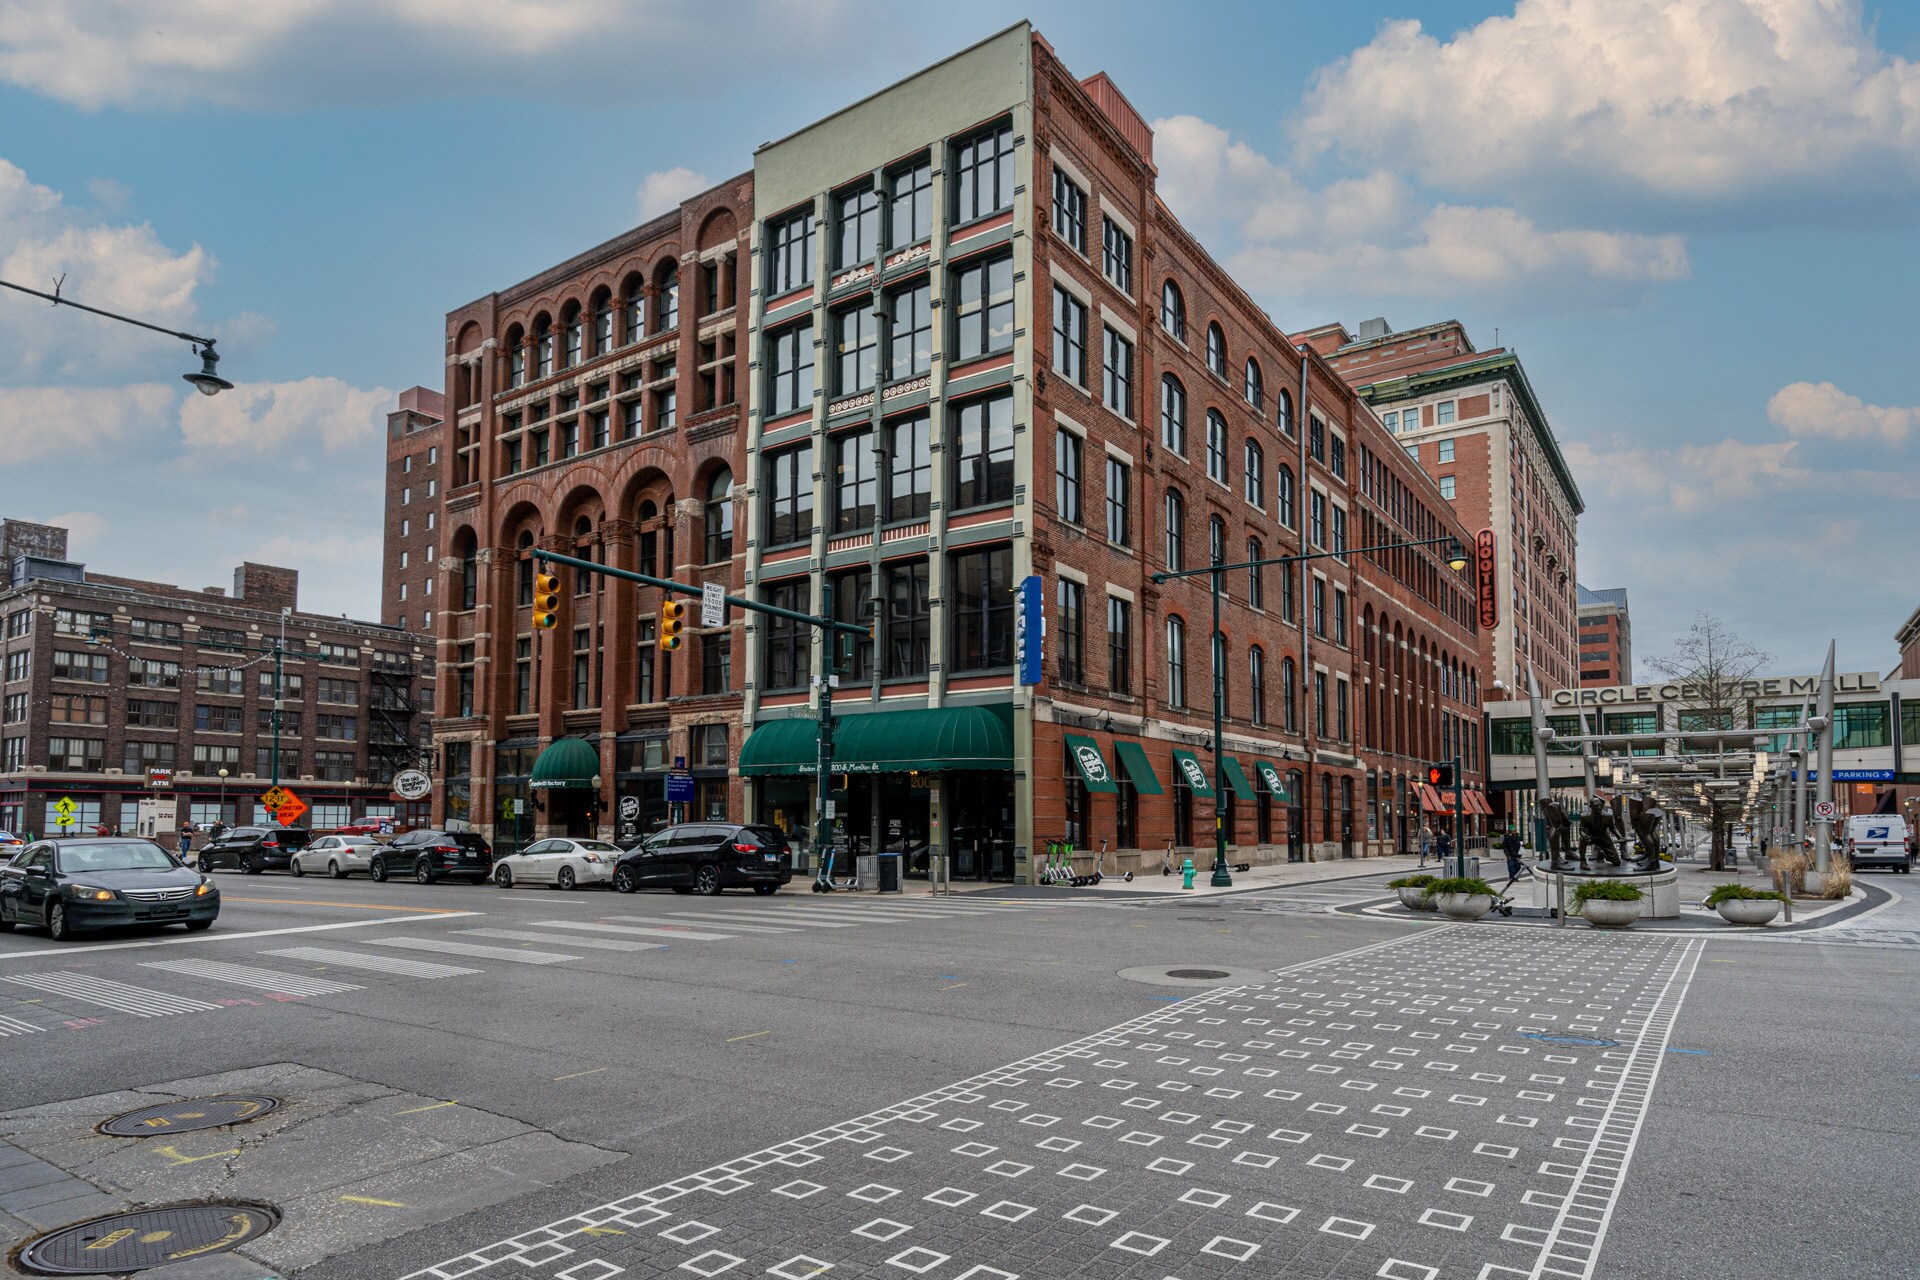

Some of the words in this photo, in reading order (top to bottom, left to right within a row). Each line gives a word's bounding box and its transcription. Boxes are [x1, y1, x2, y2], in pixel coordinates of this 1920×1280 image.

[1479, 531, 1493, 626] HOOTERS
[704, 597, 723, 606] 15000
[704, 604, 722, 612] POUNDS
[1554, 687, 1653, 705] CIRCLE
[1660, 680, 1782, 699] CENTRE
[799, 764, 816, 772] Station
[401, 780, 425, 788] spaghetti
[911, 776, 930, 788] 200
